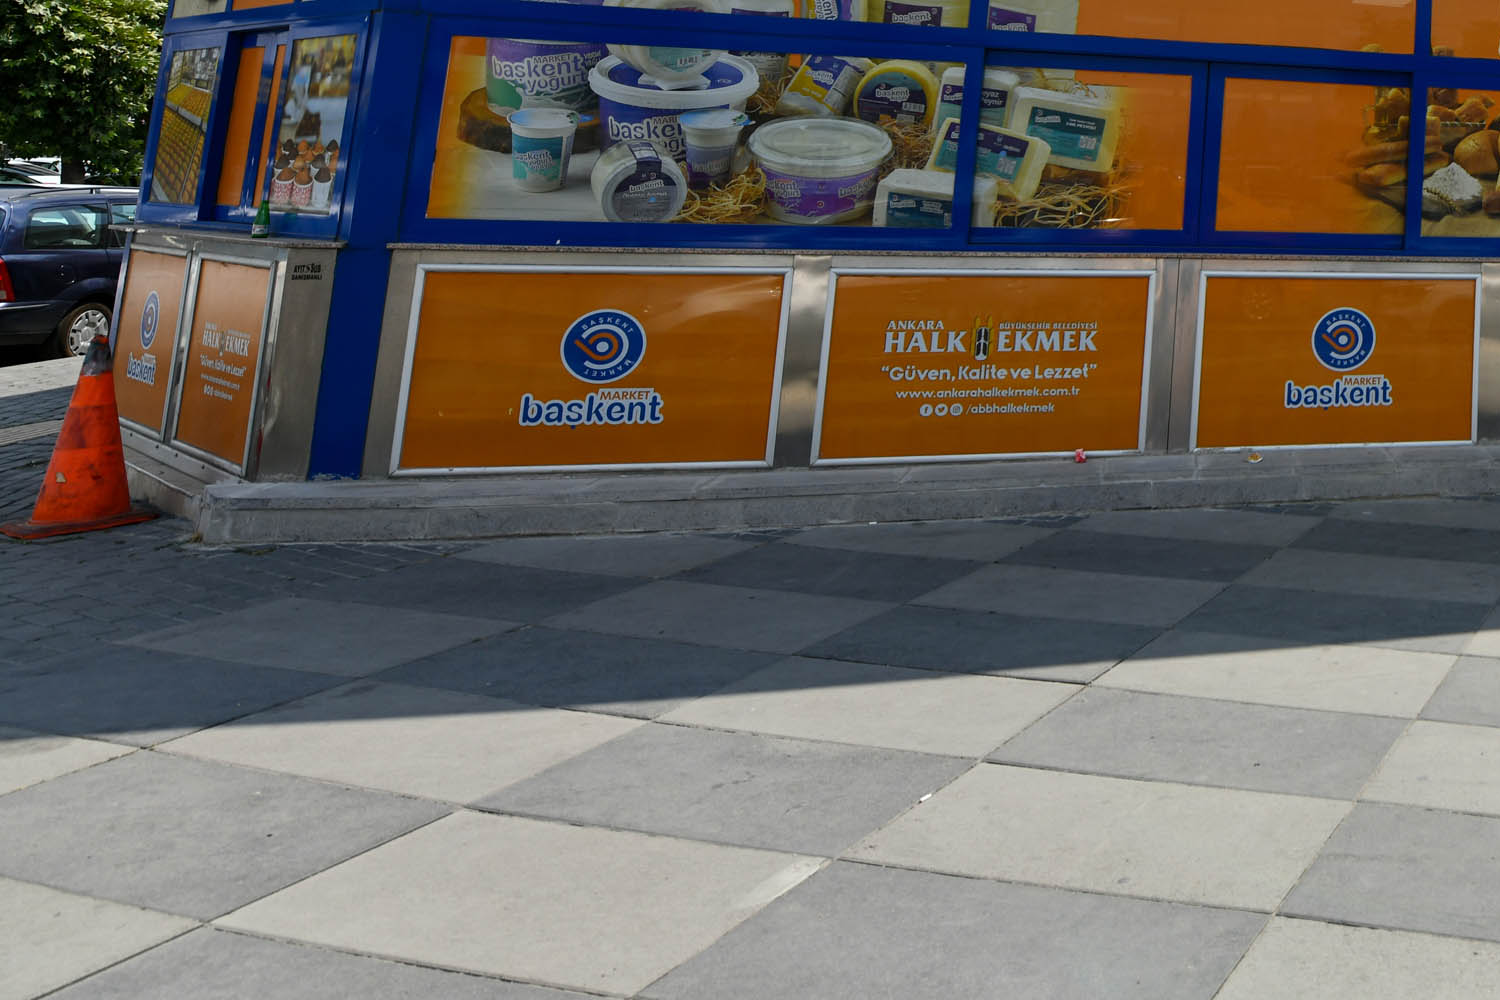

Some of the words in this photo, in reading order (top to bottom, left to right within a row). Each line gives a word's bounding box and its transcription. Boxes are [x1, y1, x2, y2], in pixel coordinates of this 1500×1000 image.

[533, 54, 571, 64] MARKET
[887, 320, 944, 330] ANKARA
[202, 329, 220, 348] HALK
[225, 339, 250, 357] EKMEK
[884, 331, 967, 353] HALK
[997, 331, 1098, 352] EKMEK
[958, 365, 1007, 380] Kalite
[1008, 369, 1032, 380] ve
[1344, 377, 1382, 385] MARKET
[600, 391, 650, 400] MARKET
[896, 386, 1080, 399] www.ankarahalkekmek.com.tr
[1286, 380, 1391, 410] başkent
[521, 394, 663, 429] başkent
